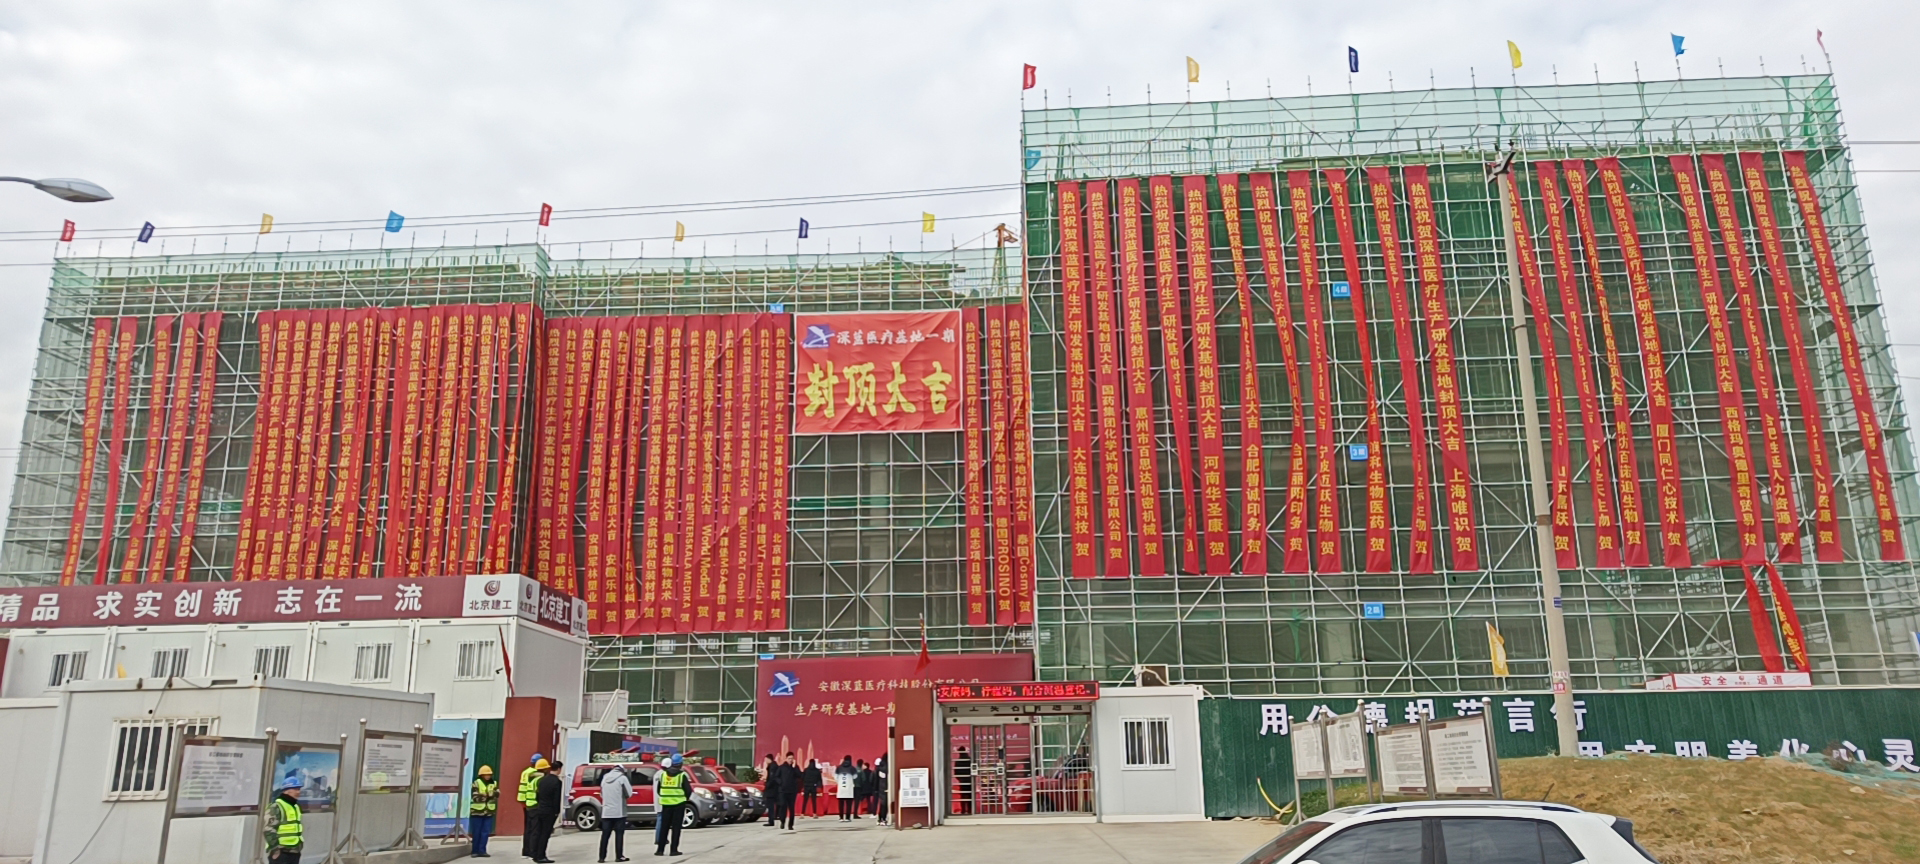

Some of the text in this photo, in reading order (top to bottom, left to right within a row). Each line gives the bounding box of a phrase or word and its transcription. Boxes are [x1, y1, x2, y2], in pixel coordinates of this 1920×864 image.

[1411, 183, 1460, 451] 热烈祝贺深蓝医疗生产研发基地封顶大吉
[836, 328, 956, 347] 深蓝医疗基地一期
[1123, 186, 1157, 555] 热烈祝贺深蓝医疗生产研发基地封顶大吉 惠州市百思达机密机械 贺
[1603, 170, 1681, 546] 热烈祝贺深蓝医疗生产研发基地封顶大吉 厦门同仁心技术 贺
[1062, 192, 1089, 556] 热烈祝贺深蓝医疗生产研发基地封顶大吉 大连美佳科技 贺
[1092, 192, 1123, 558] 热烈祝贺深蓝医疗生产研发基地封顶大吉 国药集团化学试剂合肥有限公司 贺
[1189, 190, 1225, 556] 热烈祝贺深蓝医疗生产研发基地封顶大吉 河南华圣康 贺
[437, 316, 459, 487] 热烈祝贺深蓝医疗生产研发基地封顶大吉
[803, 360, 953, 418] 封顶大吉
[590, 328, 611, 520] 热烈祝贺深蓝医疗生产研发基地封顶大吉
[649, 326, 664, 506] 热烈祝贺深蓝医疗生产研发基地封顶大吉
[664, 328, 681, 520] 热烈祝贺深蓝医疗生产研发基地封顶大吉
[557, 329, 577, 540] 热烈祝贺深蓝医疗生产研发基地封顶大吉
[536, 328, 560, 586] 热烈祝贺深蓝医疗生产研发基地封顶大吉 常州文硕包装
[966, 322, 982, 614] 热烈祝贺深蓝医疗生产研发基地封顶大吉 盛志项目管理 贺
[990, 319, 1011, 610] 热烈祝贺深蓝医疗生产研发基地封顶大吉 德国PROSINO 贺
[1009, 320, 1030, 612] 热烈祝贺深蓝医疗生产研发基地封顶大吉 泰国Cosmy 贺
[1725, 407, 1755, 526] 西格玛奥德里奇贸易
[1744, 533, 1757, 546] 贺
[1449, 468, 1470, 531] 上海唯识
[701, 524, 712, 556] World
[1247, 539, 1261, 553] 贺
[1290, 538, 1302, 551] 贺
[1321, 541, 1334, 555] 贺
[1371, 538, 1385, 551] 贺
[1416, 541, 1427, 554] 贺
[1456, 537, 1472, 552] 贺
[1555, 535, 1569, 550] 贺
[1600, 536, 1612, 549] 贺
[1626, 531, 1641, 545] 贺
[1780, 532, 1795, 545] 贺
[1819, 531, 1833, 544] 贺
[1881, 529, 1896, 542] 贺
[268, 531, 284, 580] 威海丽华
[358, 551, 370, 579] 上海
[771, 533, 782, 600] 北京建工建筑
[605, 554, 617, 603] 安徽乐康
[683, 571, 692, 608] MEDIKA
[700, 559, 711, 597] Medical
[737, 573, 746, 603] GmbH
[756, 562, 765, 604] medical
[93, 588, 242, 620] 求实创新
[274, 584, 423, 614] 志在一流
[469, 600, 512, 611] 北京建工
[519, 601, 536, 615] 北京建工
[540, 591, 570, 626] 北京建工
[588, 609, 597, 620] 贺
[606, 611, 617, 622] 贺
[625, 609, 636, 619] 贺
[644, 607, 654, 618] 贺
[661, 607, 671, 618] 贺
[697, 606, 709, 618] 贺
[735, 609, 744, 618] 贺
[753, 610, 763, 620] 贺
[771, 608, 780, 618] 贺
[681, 613, 690, 622] 贺
[717, 612, 726, 622] 贺
[1701, 676, 1784, 686] 安全 通道
